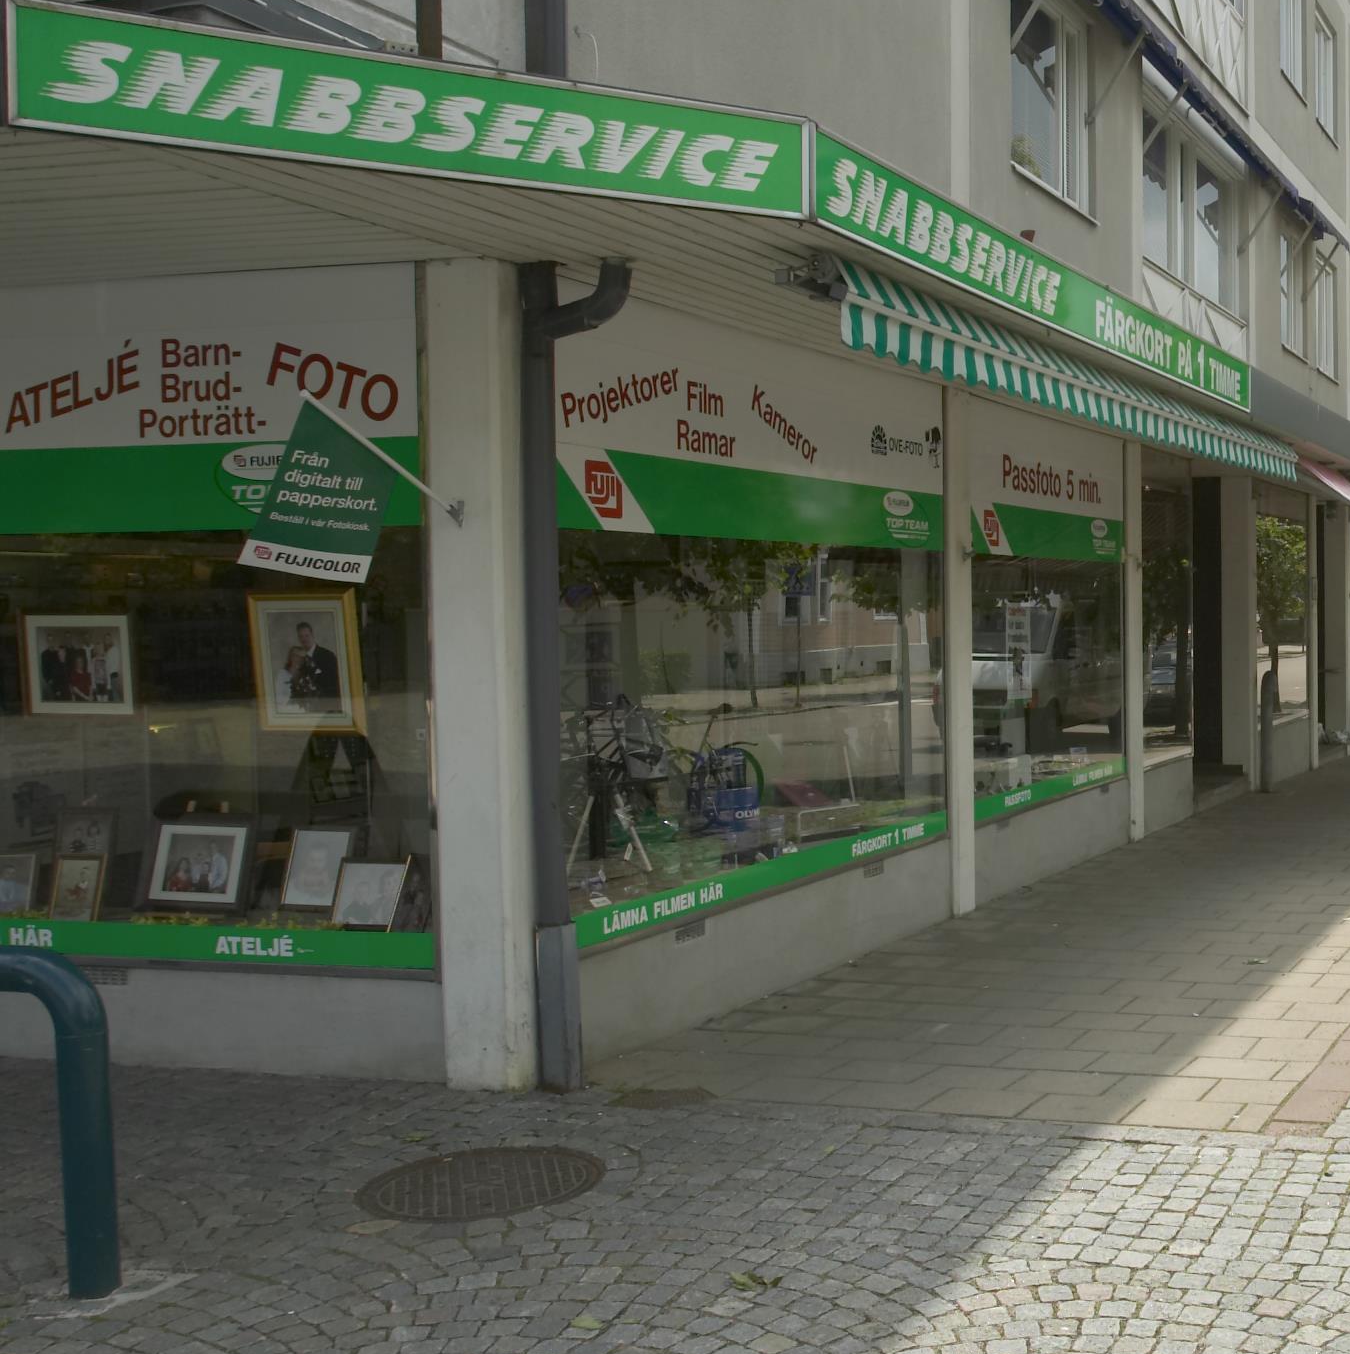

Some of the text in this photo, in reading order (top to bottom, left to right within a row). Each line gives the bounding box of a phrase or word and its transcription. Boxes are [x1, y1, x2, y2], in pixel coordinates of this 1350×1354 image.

[38, 41, 780, 193] SNABBSERVICE
[825, 157, 1062, 316] SNABBSERVICE
[161, 338, 242, 368] Barn-
[1095, 296, 1241, 402] FÄRGKORT PÅ 1 TIMME
[5, 338, 140, 434] ATELJÉ
[161, 372, 242, 403] Brud-
[266, 342, 399, 422] FOTO
[560, 366, 680, 428] Projektorer
[686, 381, 724, 417] Film
[139, 404, 267, 438] Porträtt-
[676, 419, 736, 458] Ramar
[751, 384, 818, 464] Kameror
[291, 450, 330, 468] Från
[231, 484, 271, 500] TO
[284, 470, 363, 491] digitalt till
[1002, 453, 1101, 503] Passfoto 5 min.
[276, 490, 378, 511] papperskort.
[275, 552, 361, 574] FUJICOLOR
[1004, 789, 1032, 808] PASSFOTO
[852, 833, 892, 858] FÄRGKORT
[902, 822, 925, 844] TIMME
[603, 881, 724, 934] LÄMNA FILMEN HÄR
[9, 924, 53, 947] HÄR
[215, 934, 294, 957] ATELJÉ
